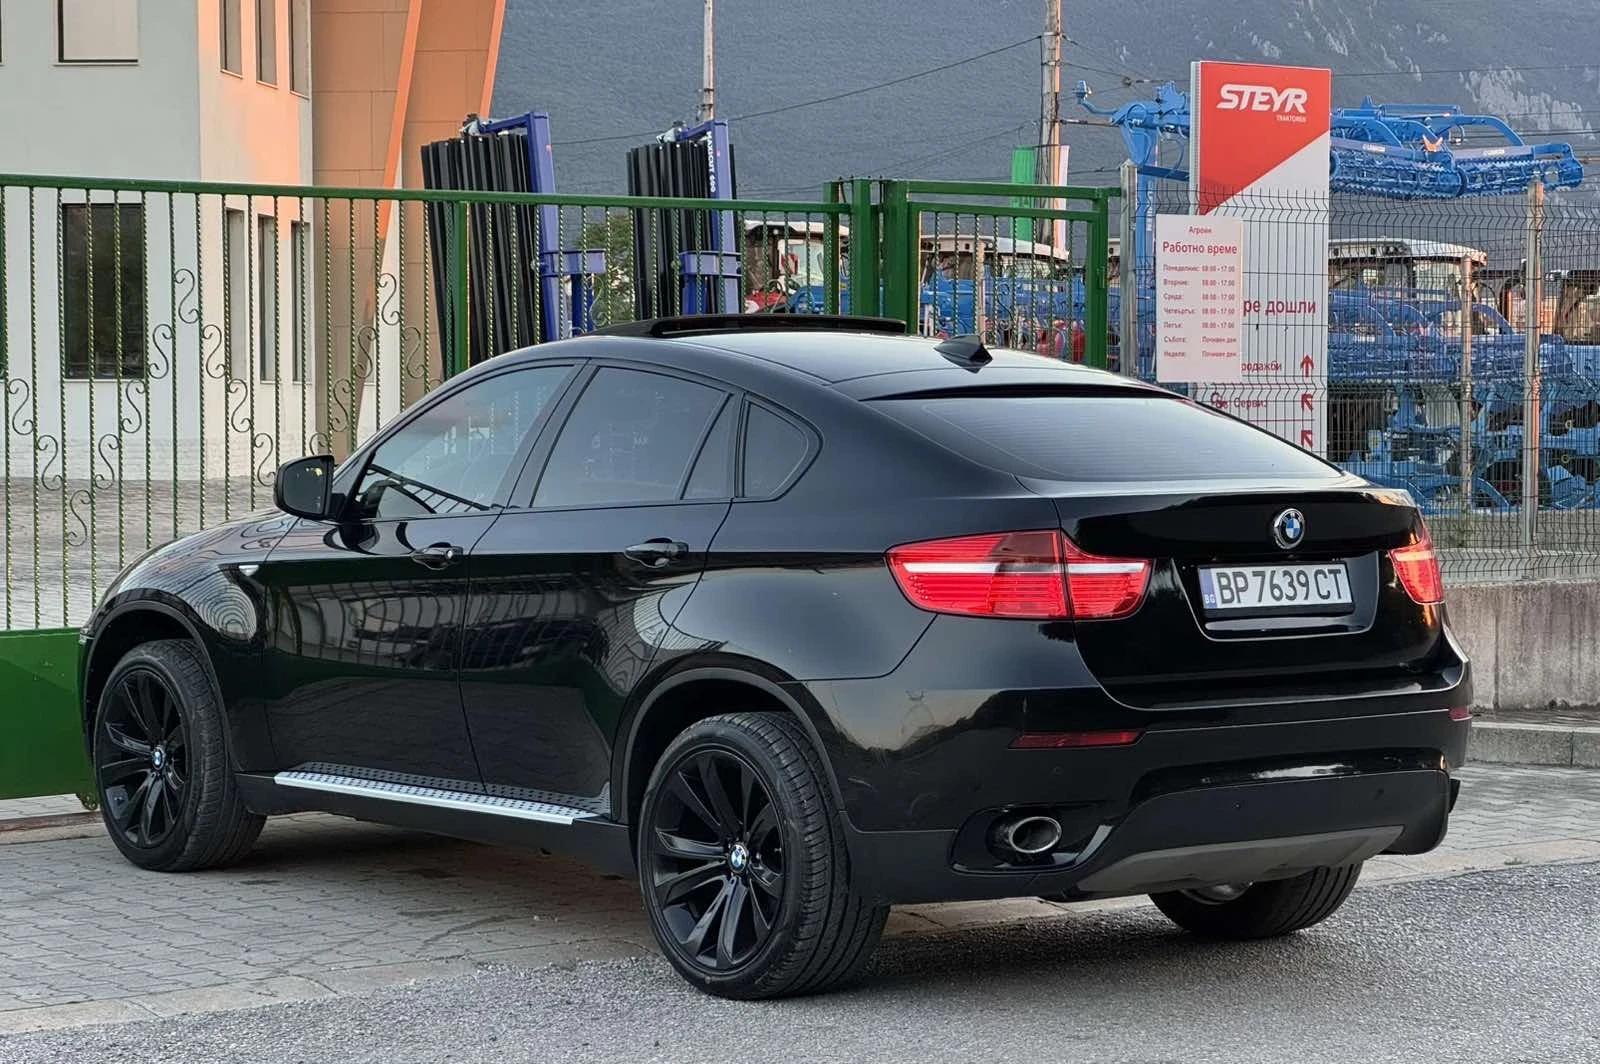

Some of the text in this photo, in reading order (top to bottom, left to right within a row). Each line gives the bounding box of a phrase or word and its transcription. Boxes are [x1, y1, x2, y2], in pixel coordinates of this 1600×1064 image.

[1216, 83, 1308, 114] STEYR
[1162, 241, 1238, 256] Работно време
[1243, 300, 1316, 317] ре дошли
[1241, 360, 1282, 373] родажби
